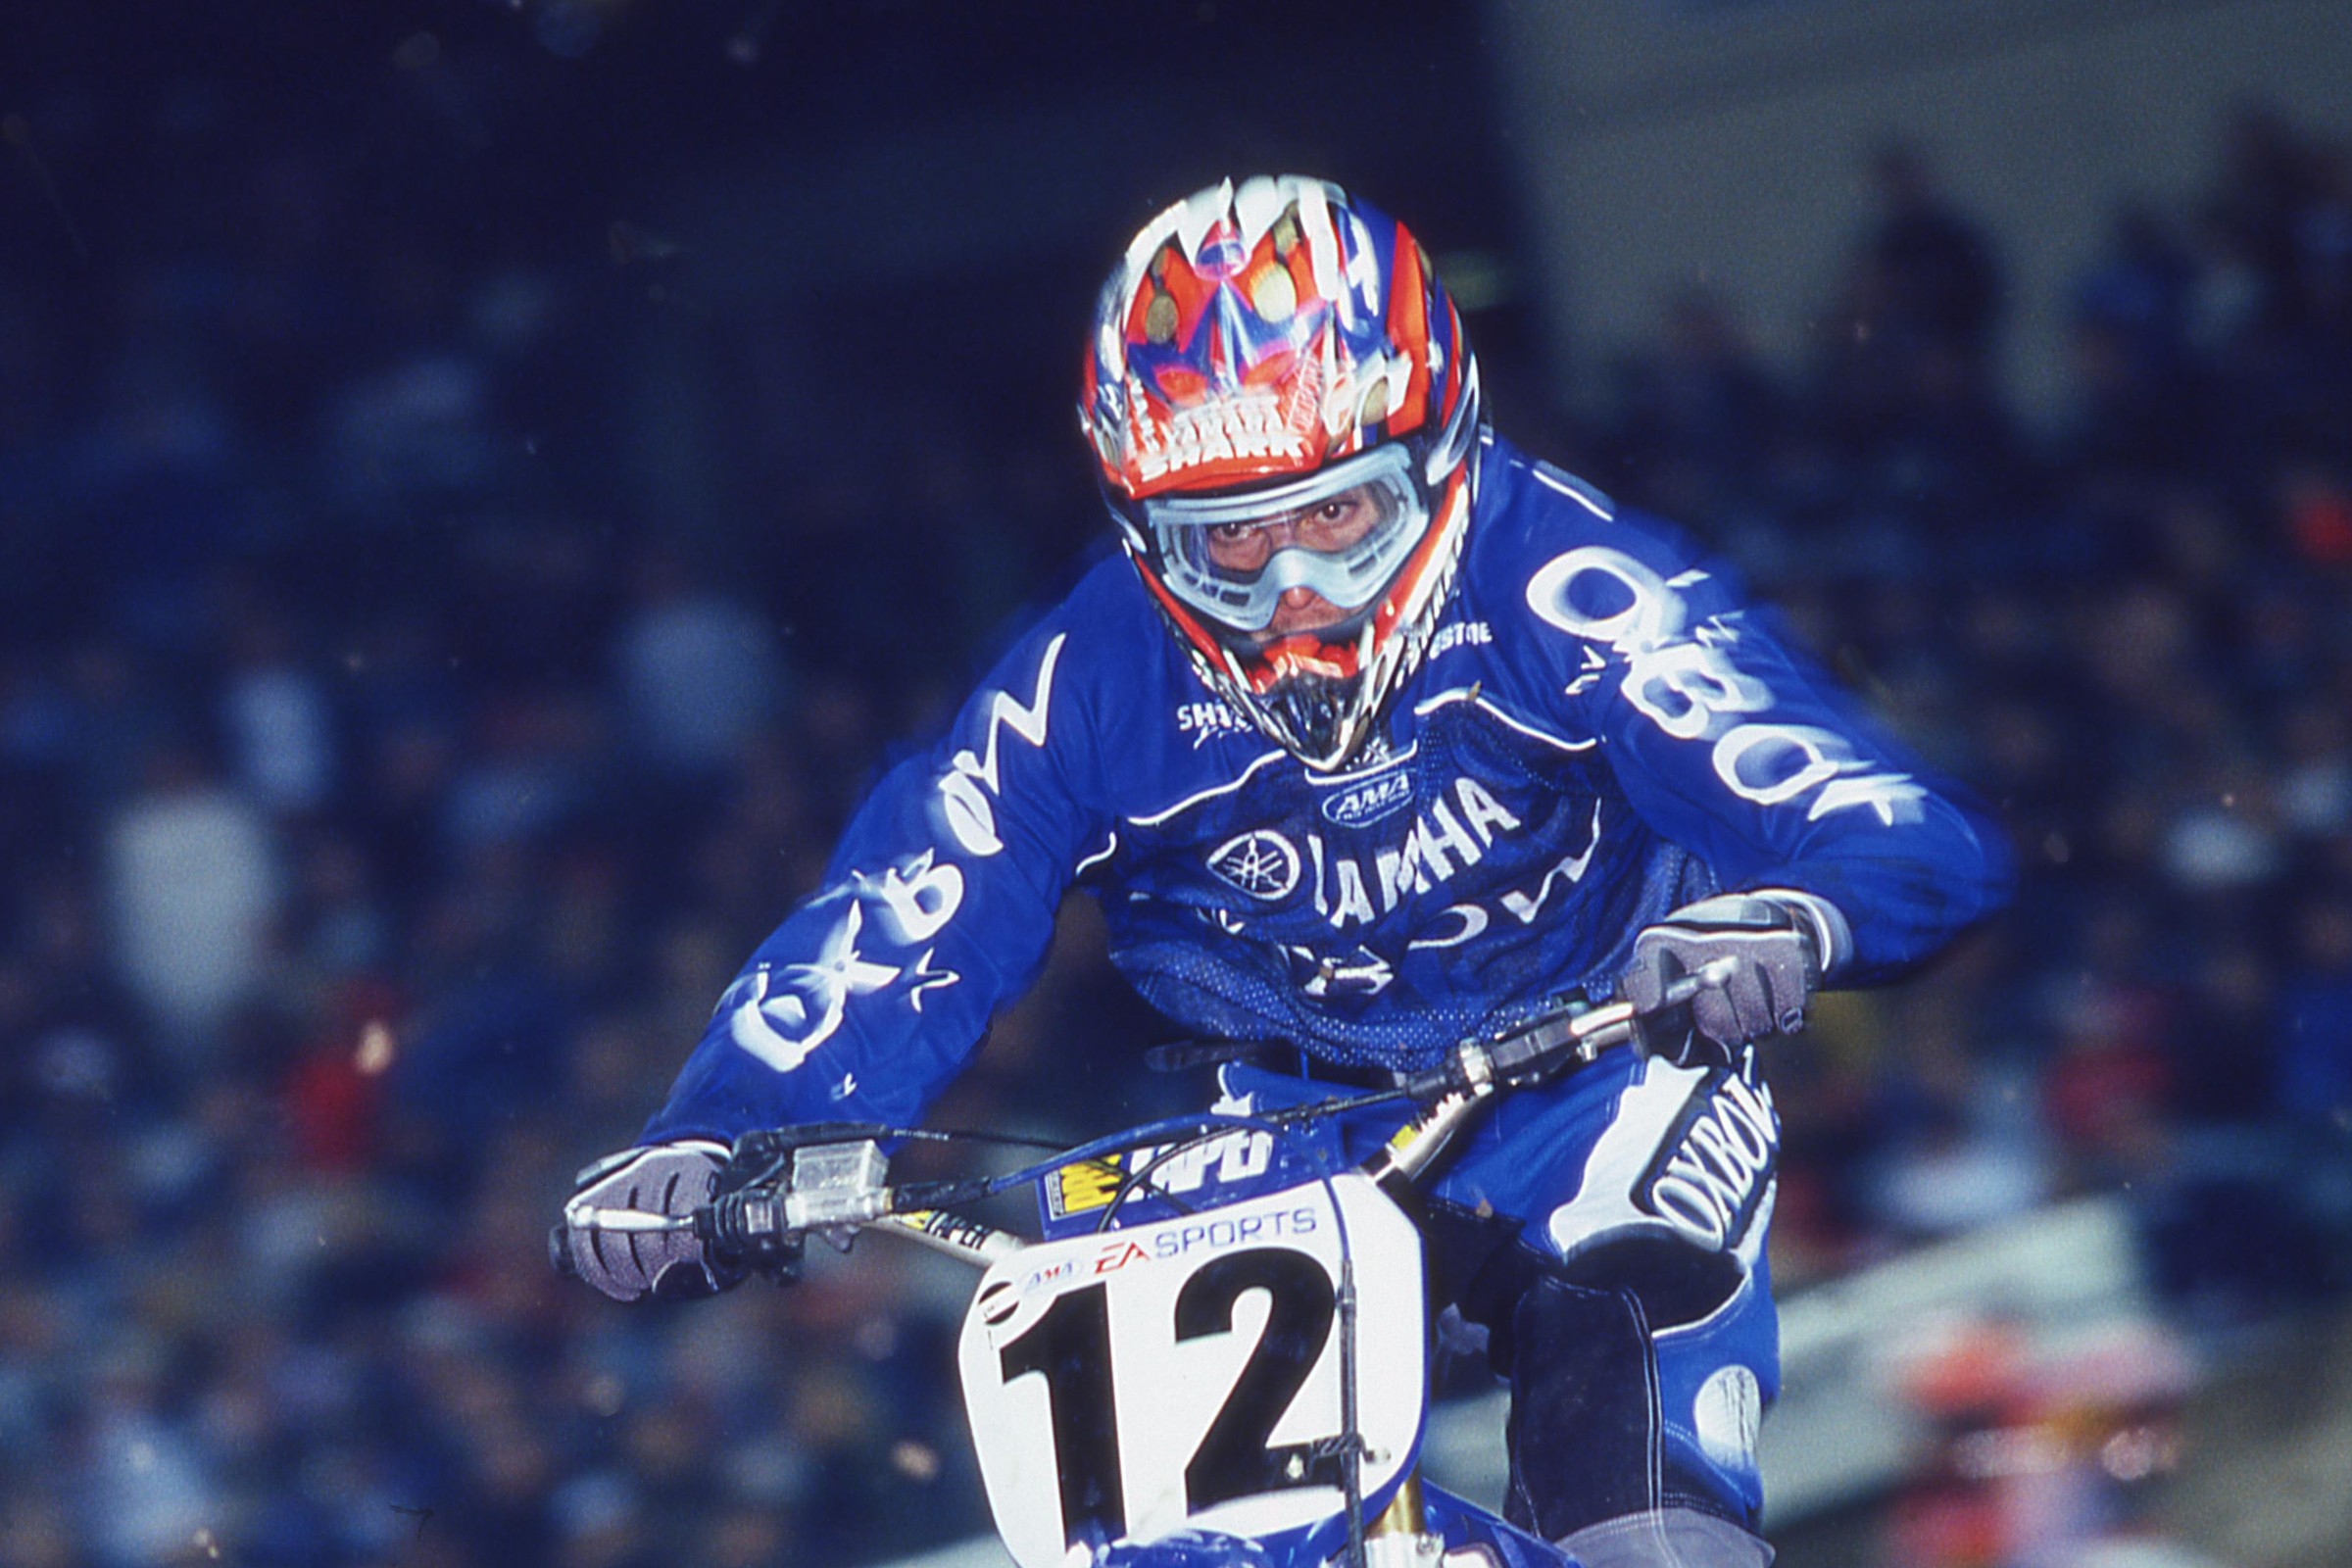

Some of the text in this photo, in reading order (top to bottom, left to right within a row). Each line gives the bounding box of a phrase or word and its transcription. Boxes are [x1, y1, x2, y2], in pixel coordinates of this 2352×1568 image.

[1139, 431, 1305, 482] SHARK
[1336, 772, 1410, 820] AMA
[1652, 1045, 1782, 1252] OXBOW
[1095, 1206, 1317, 1275] EA SPORTS
[1025, 1260, 1073, 1294] AMA
[999, 1246, 1345, 1554] 12
